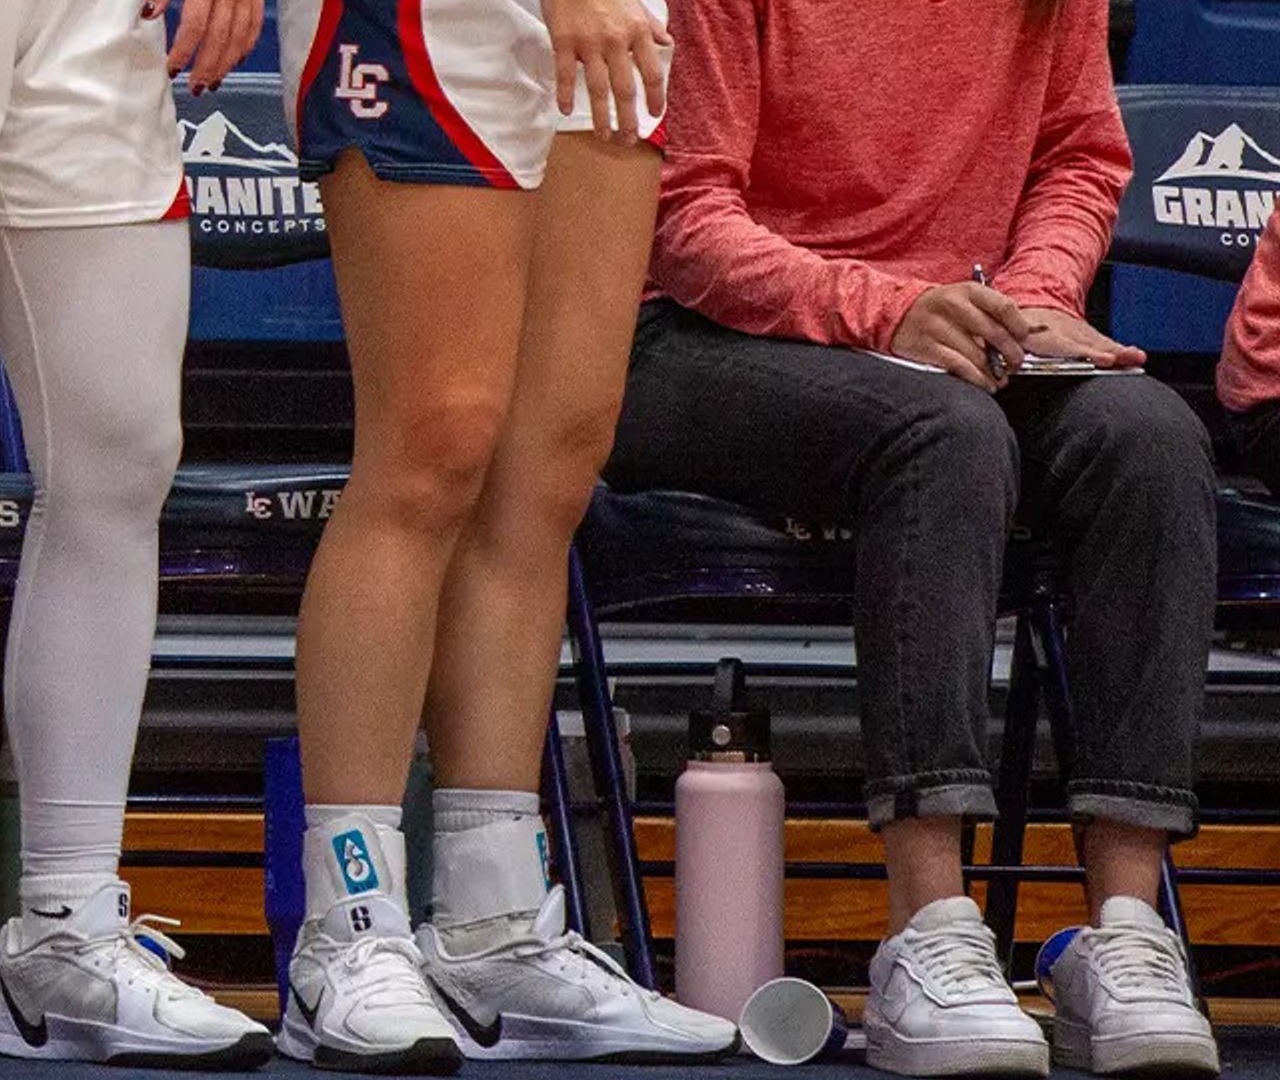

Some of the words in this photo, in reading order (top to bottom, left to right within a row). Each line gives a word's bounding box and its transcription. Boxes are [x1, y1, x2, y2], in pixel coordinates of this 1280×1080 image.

[333, 43, 389, 119] LC
[186, 175, 325, 216] ANITE
[1151, 185, 1278, 230] GRAN
[200, 218, 328, 235] CONCEPTS
